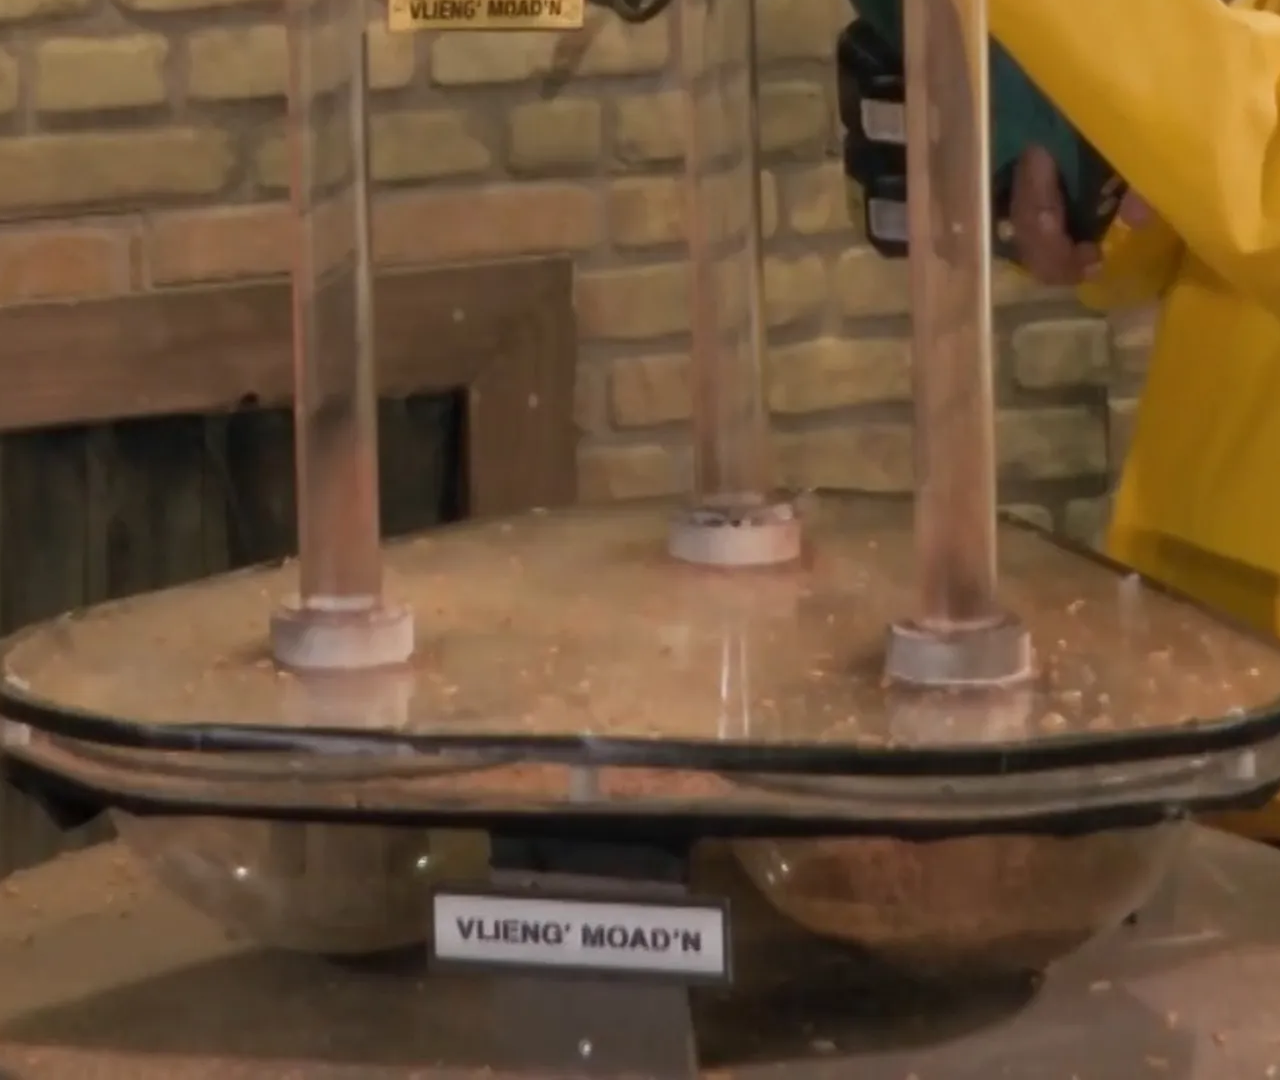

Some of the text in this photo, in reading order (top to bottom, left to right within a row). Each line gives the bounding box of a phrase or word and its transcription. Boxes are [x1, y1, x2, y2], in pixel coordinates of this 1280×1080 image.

[409, 0, 482, 19] VLIENG'
[456, 917, 702, 953] VLIENG' MOAD'N
